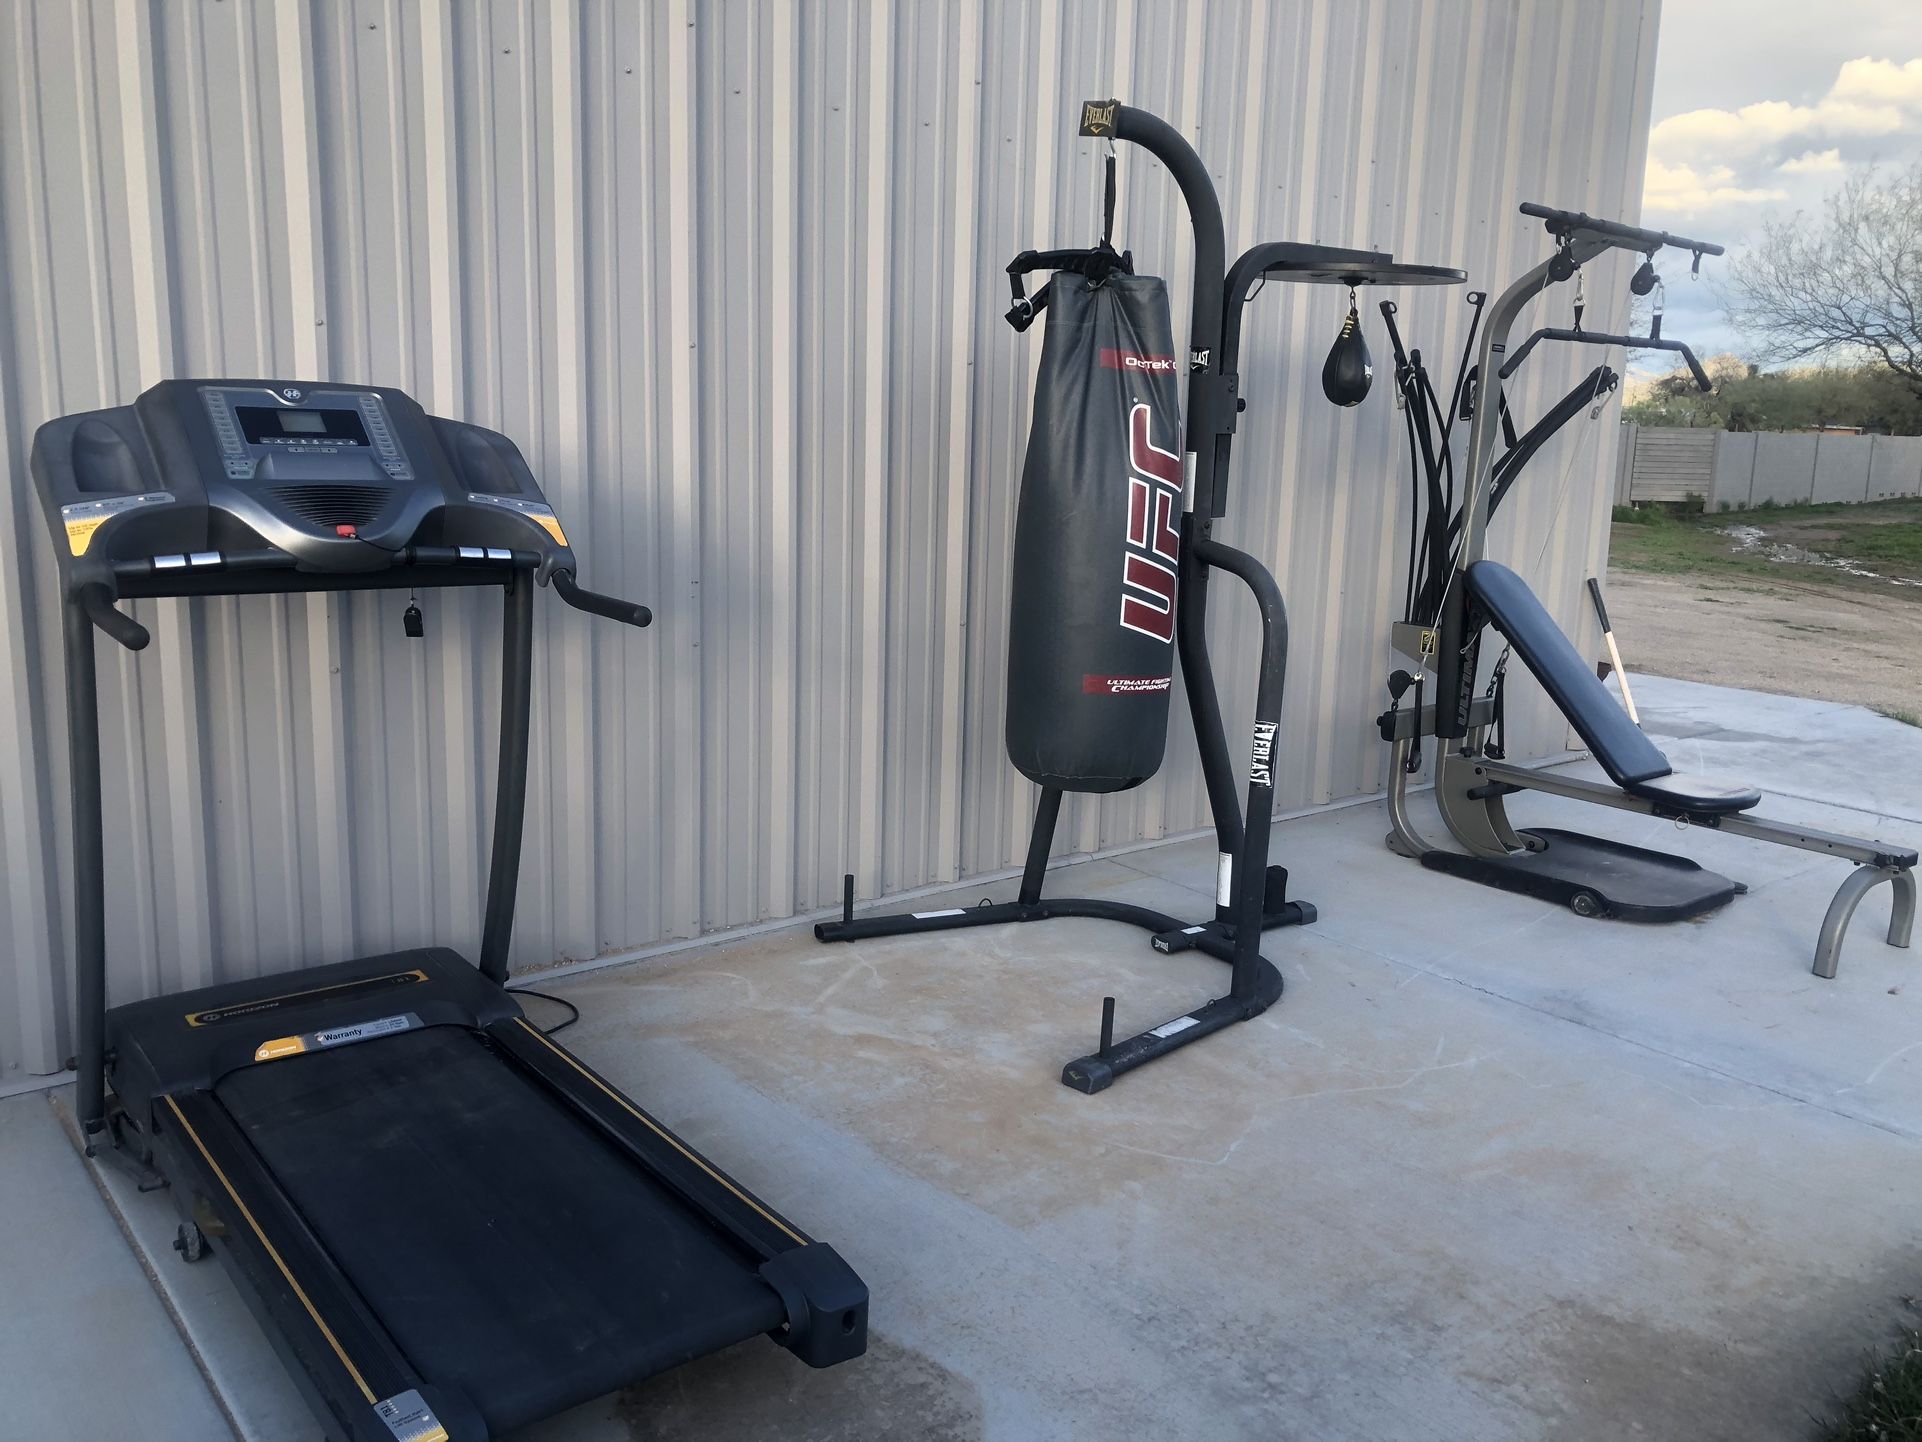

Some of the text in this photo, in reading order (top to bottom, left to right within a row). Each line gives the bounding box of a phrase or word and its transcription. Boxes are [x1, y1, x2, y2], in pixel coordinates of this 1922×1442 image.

[1084, 104, 1114, 127] EVERLAST
[1120, 403, 1183, 644] UFC
[1250, 723, 1277, 786] EVERLAST
[323, 1028, 362, 1042] Warranty
